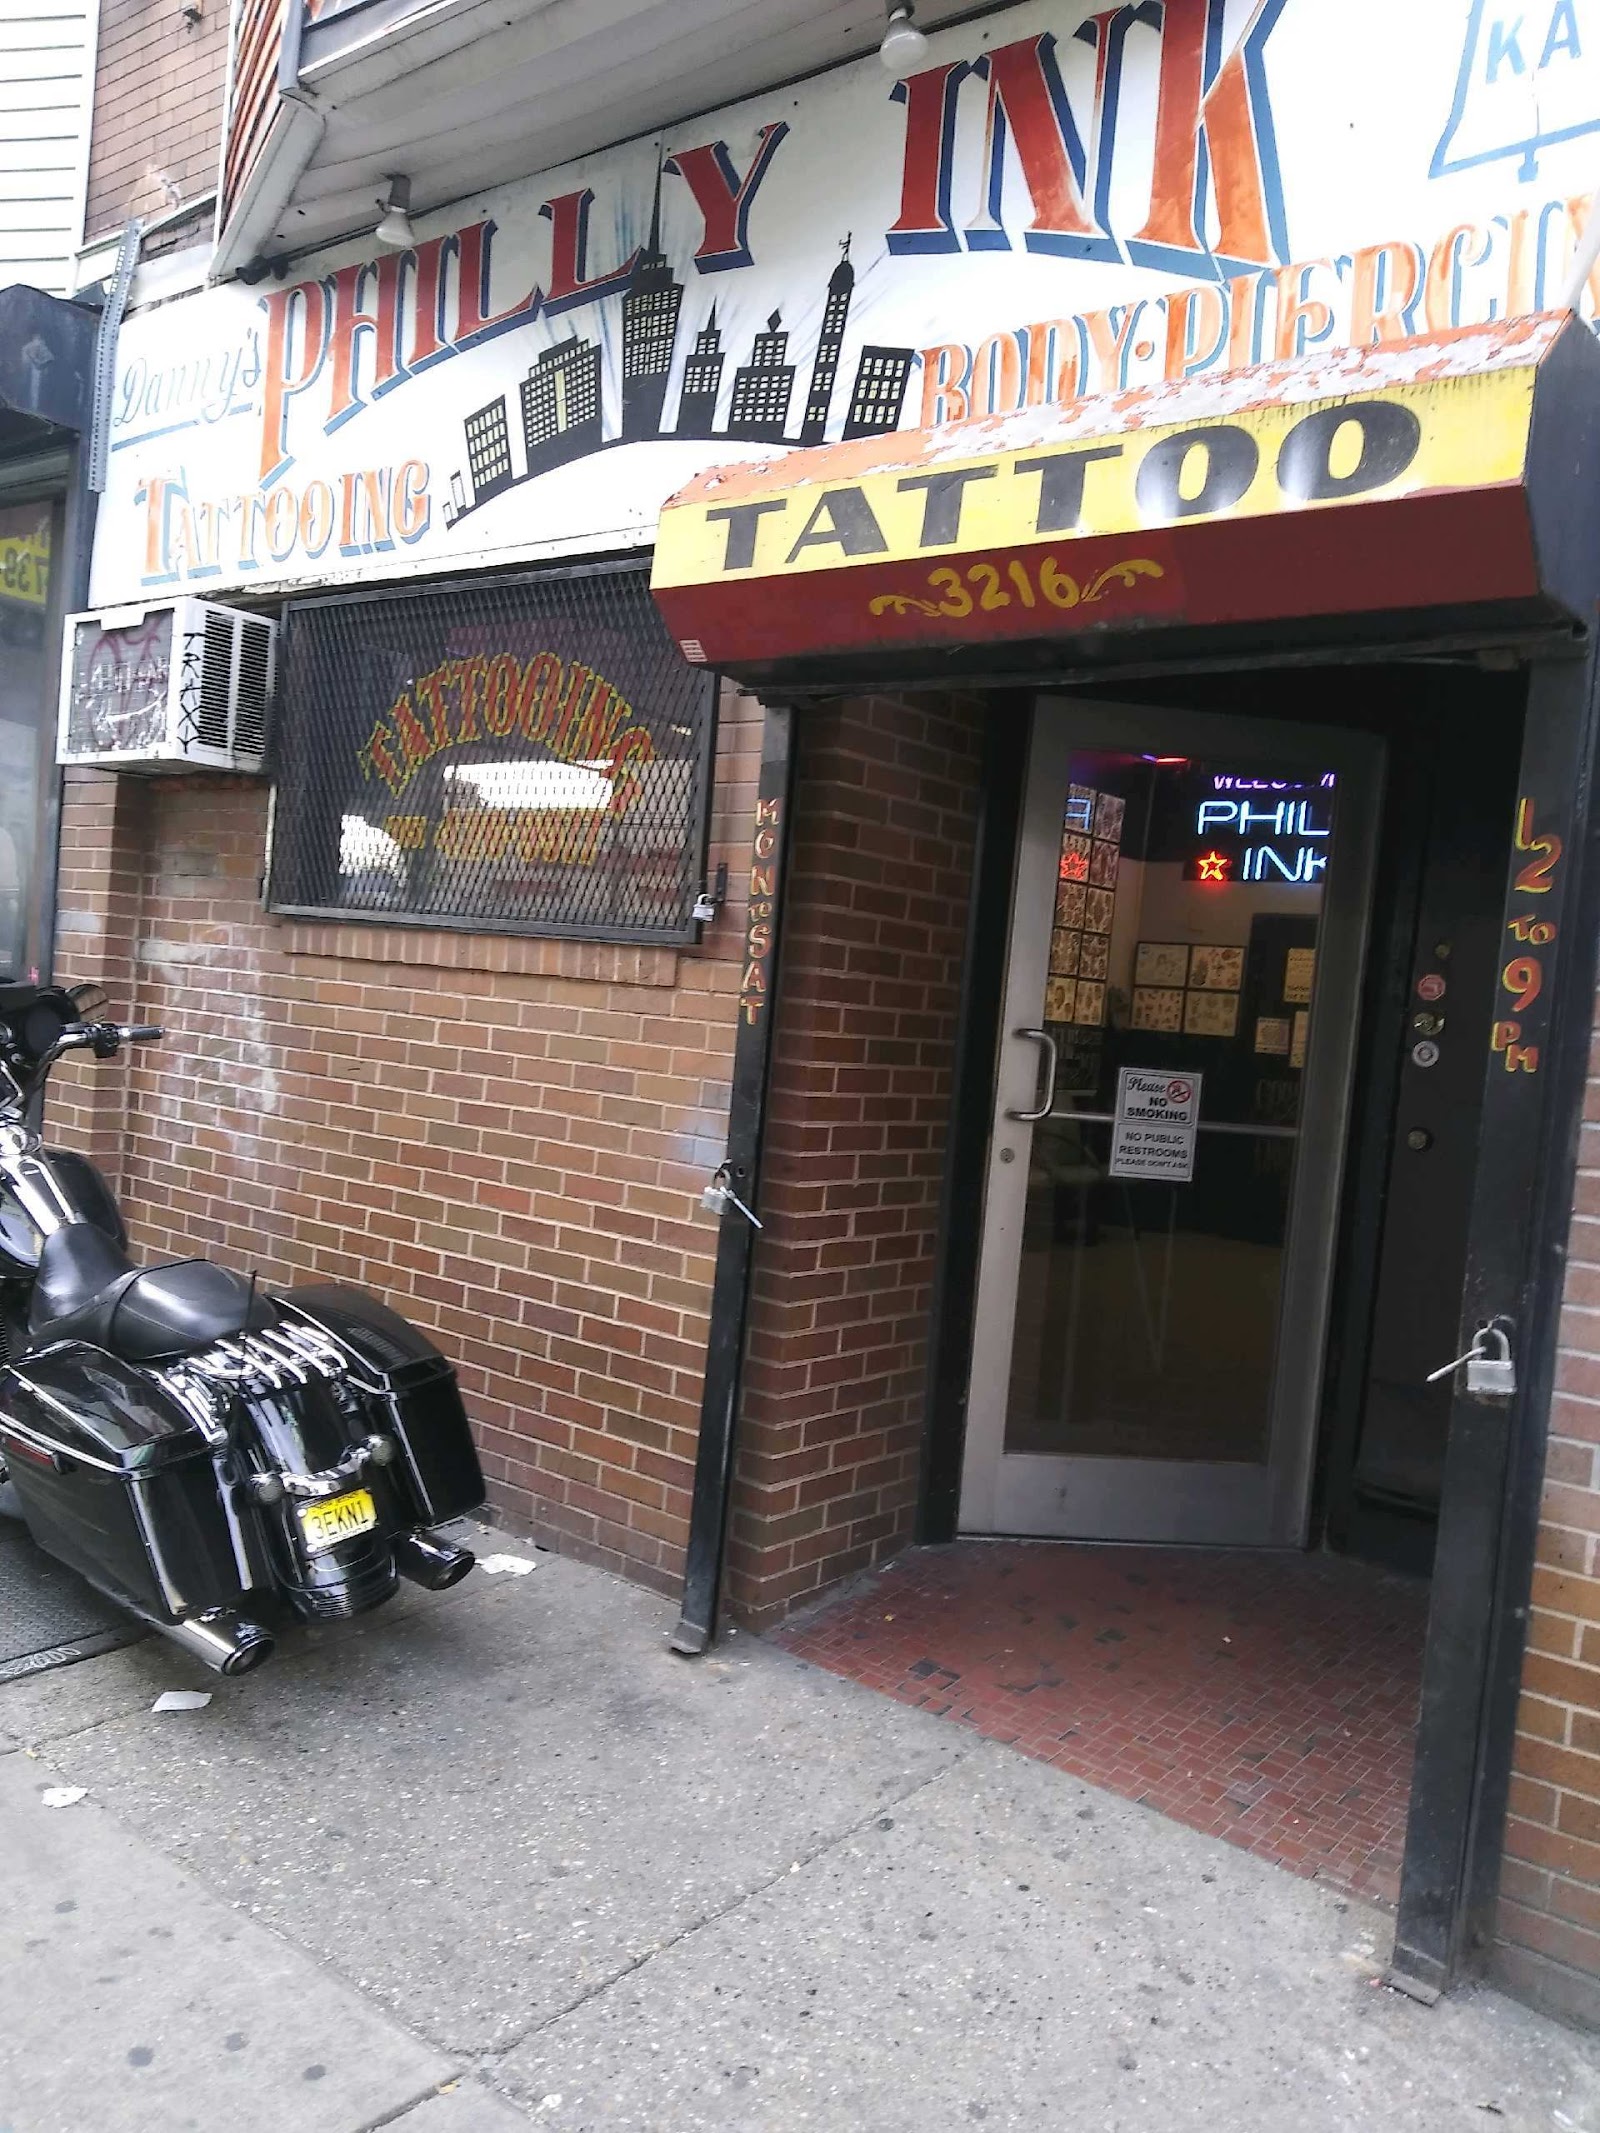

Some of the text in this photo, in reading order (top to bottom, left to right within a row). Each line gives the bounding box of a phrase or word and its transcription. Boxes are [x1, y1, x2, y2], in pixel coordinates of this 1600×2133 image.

[259, 0, 1292, 491] PHILLY INK
[113, 328, 262, 427] Danny's
[916, 303, 1138, 428] BODY
[706, 400, 1421, 571] TATTOO
[134, 456, 432, 587] TATTOOING
[927, 556, 1080, 618] 3216
[356, 651, 656, 819] TATTOOING
[750, 798, 781, 897] MON
[1197, 800, 1330, 835] PHIL
[740, 924, 773, 1026] SAT
[1502, 956, 1542, 1012] 9
[1491, 1021, 1539, 1073] PM
[1127, 1077, 1166, 1093] Please
[1127, 1107, 1188, 1121] SMOKING
[1149, 1097, 1168, 1107] NO
[1119, 1145, 1188, 1159] RESTROOMS
[1125, 1131, 1184, 1145] NO PUBLIC
